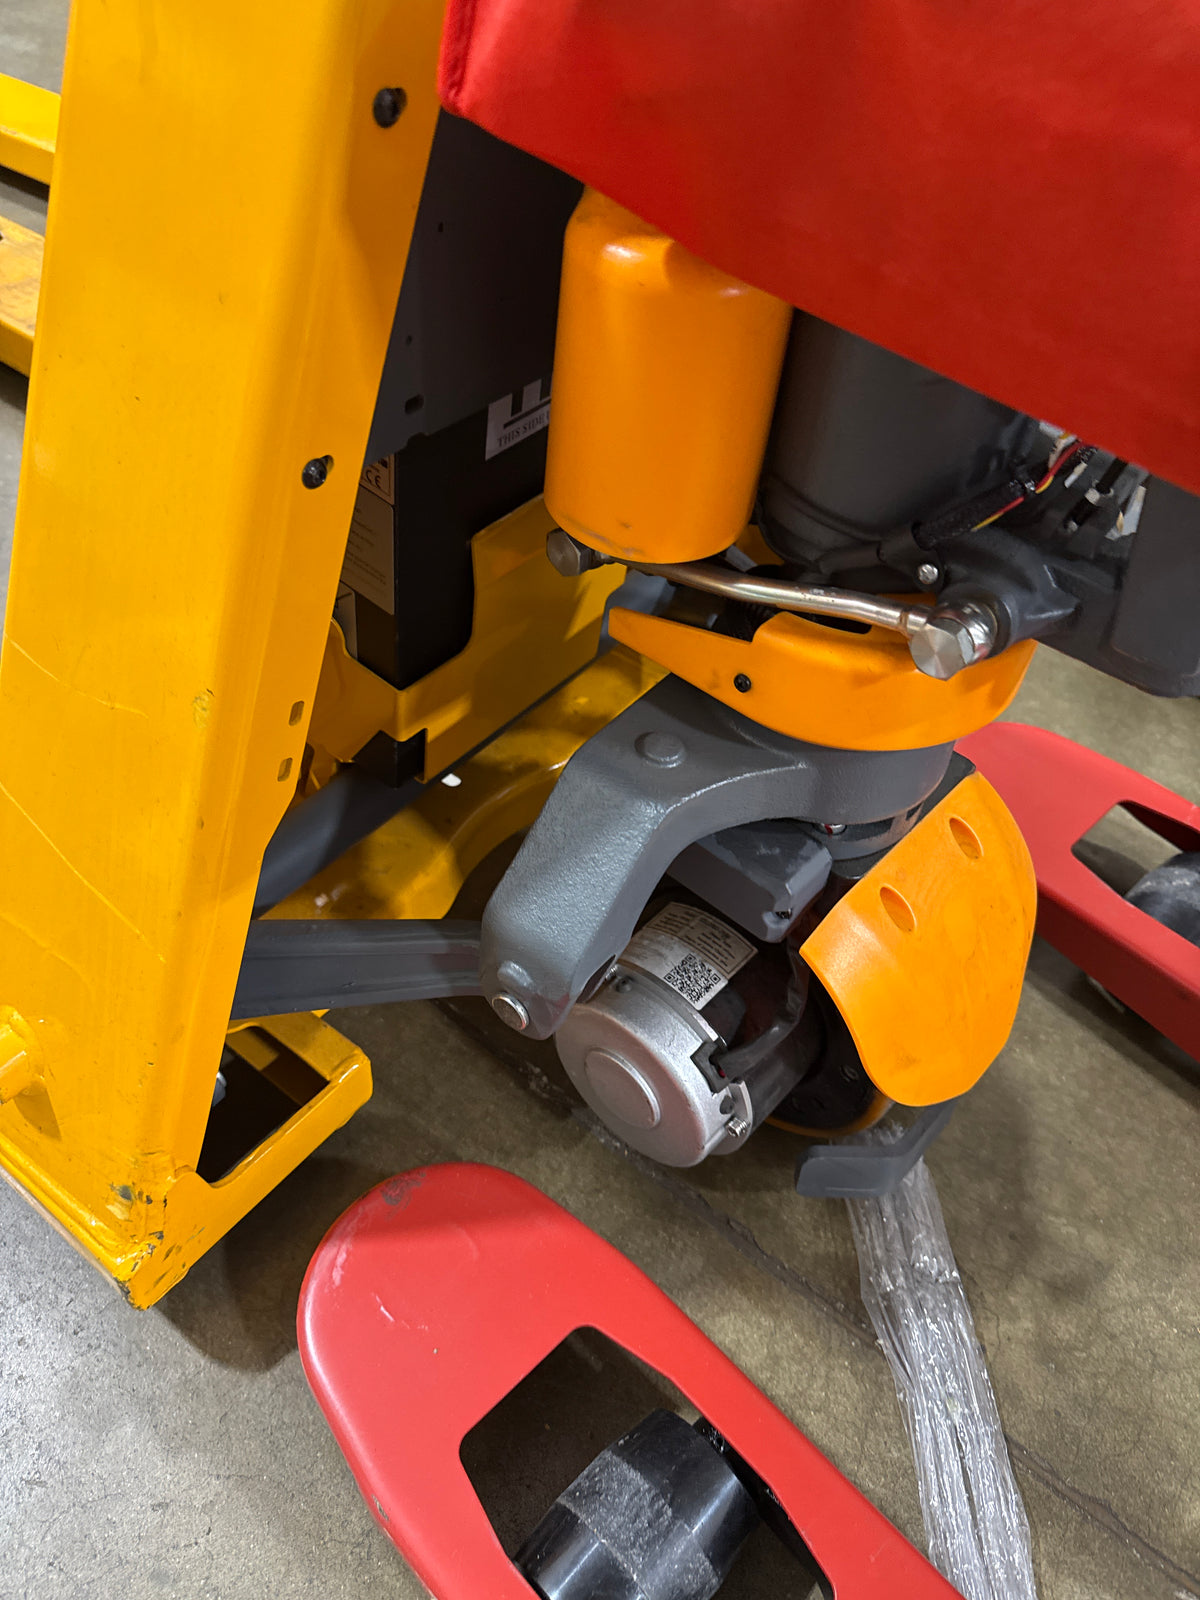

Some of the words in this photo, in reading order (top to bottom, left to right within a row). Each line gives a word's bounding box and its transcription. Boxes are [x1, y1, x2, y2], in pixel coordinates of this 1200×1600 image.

[497, 427, 521, 448] THIS
[522, 412, 546, 434] SIDE
[365, 469, 382, 490] CE
